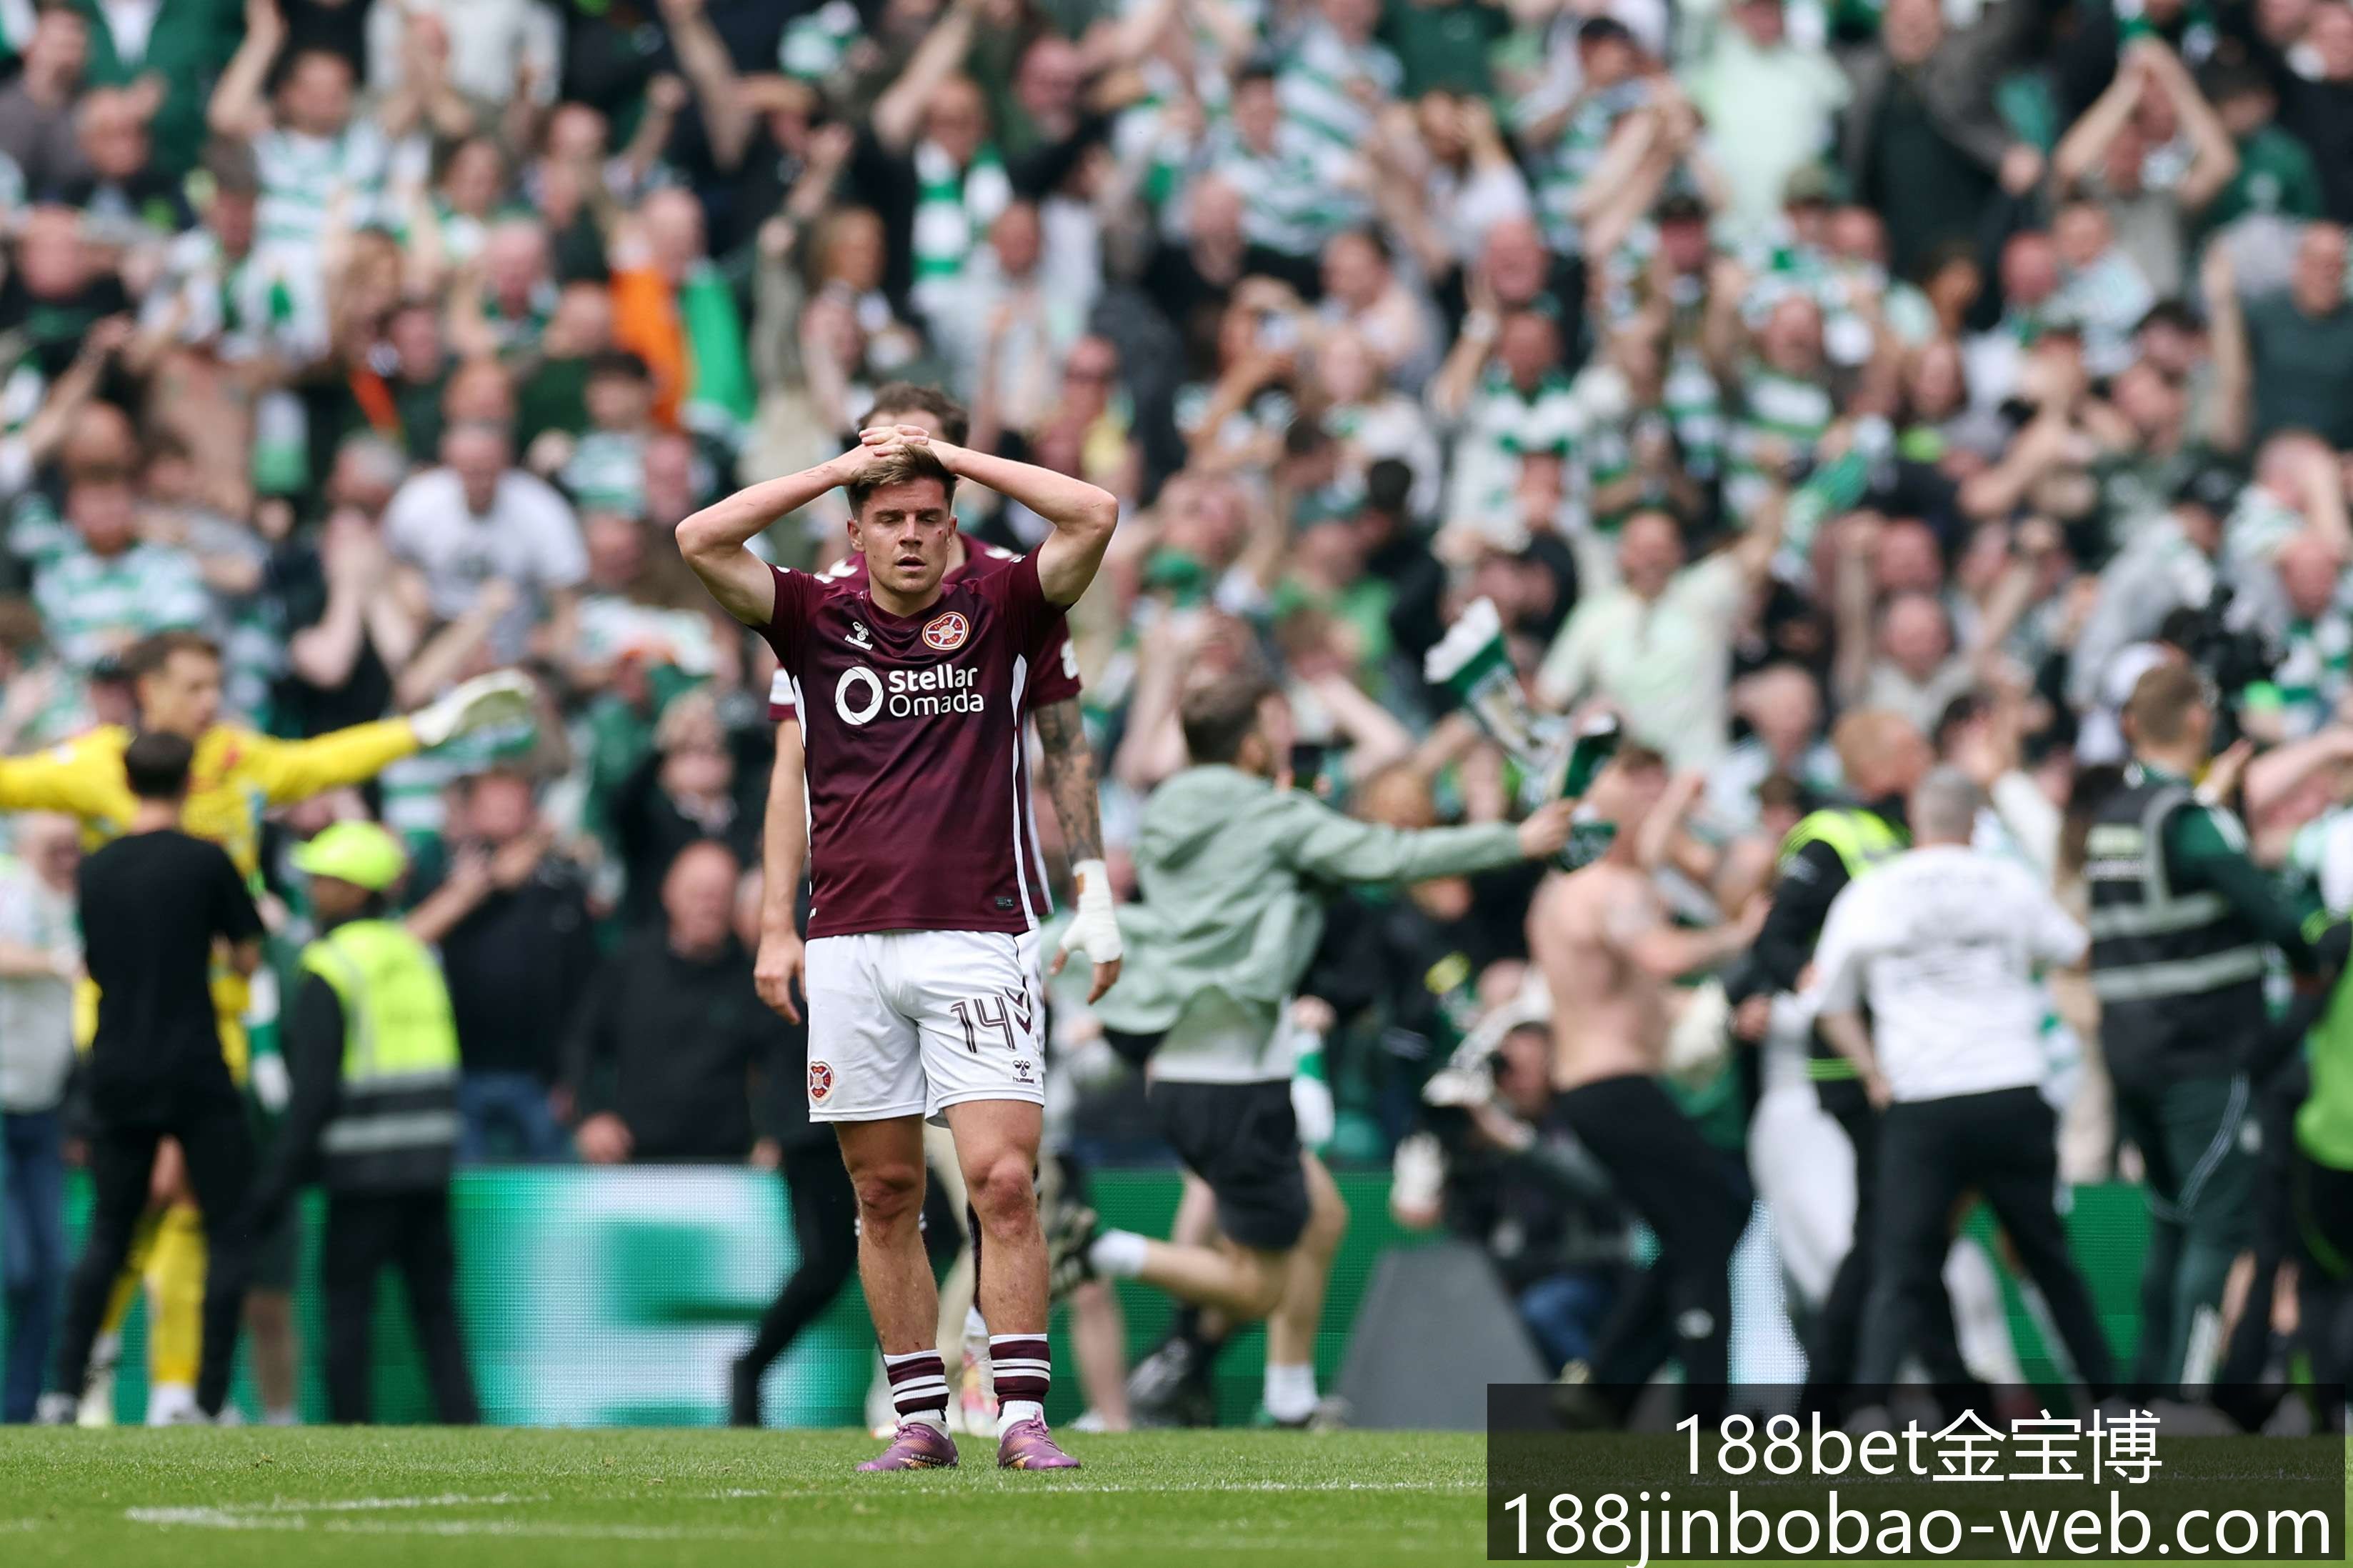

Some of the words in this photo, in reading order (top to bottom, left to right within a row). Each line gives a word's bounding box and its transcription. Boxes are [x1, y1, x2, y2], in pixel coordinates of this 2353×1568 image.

[889, 664, 978, 693] Stellar
[889, 688, 984, 717] Omada
[950, 996, 1016, 1053] 14
